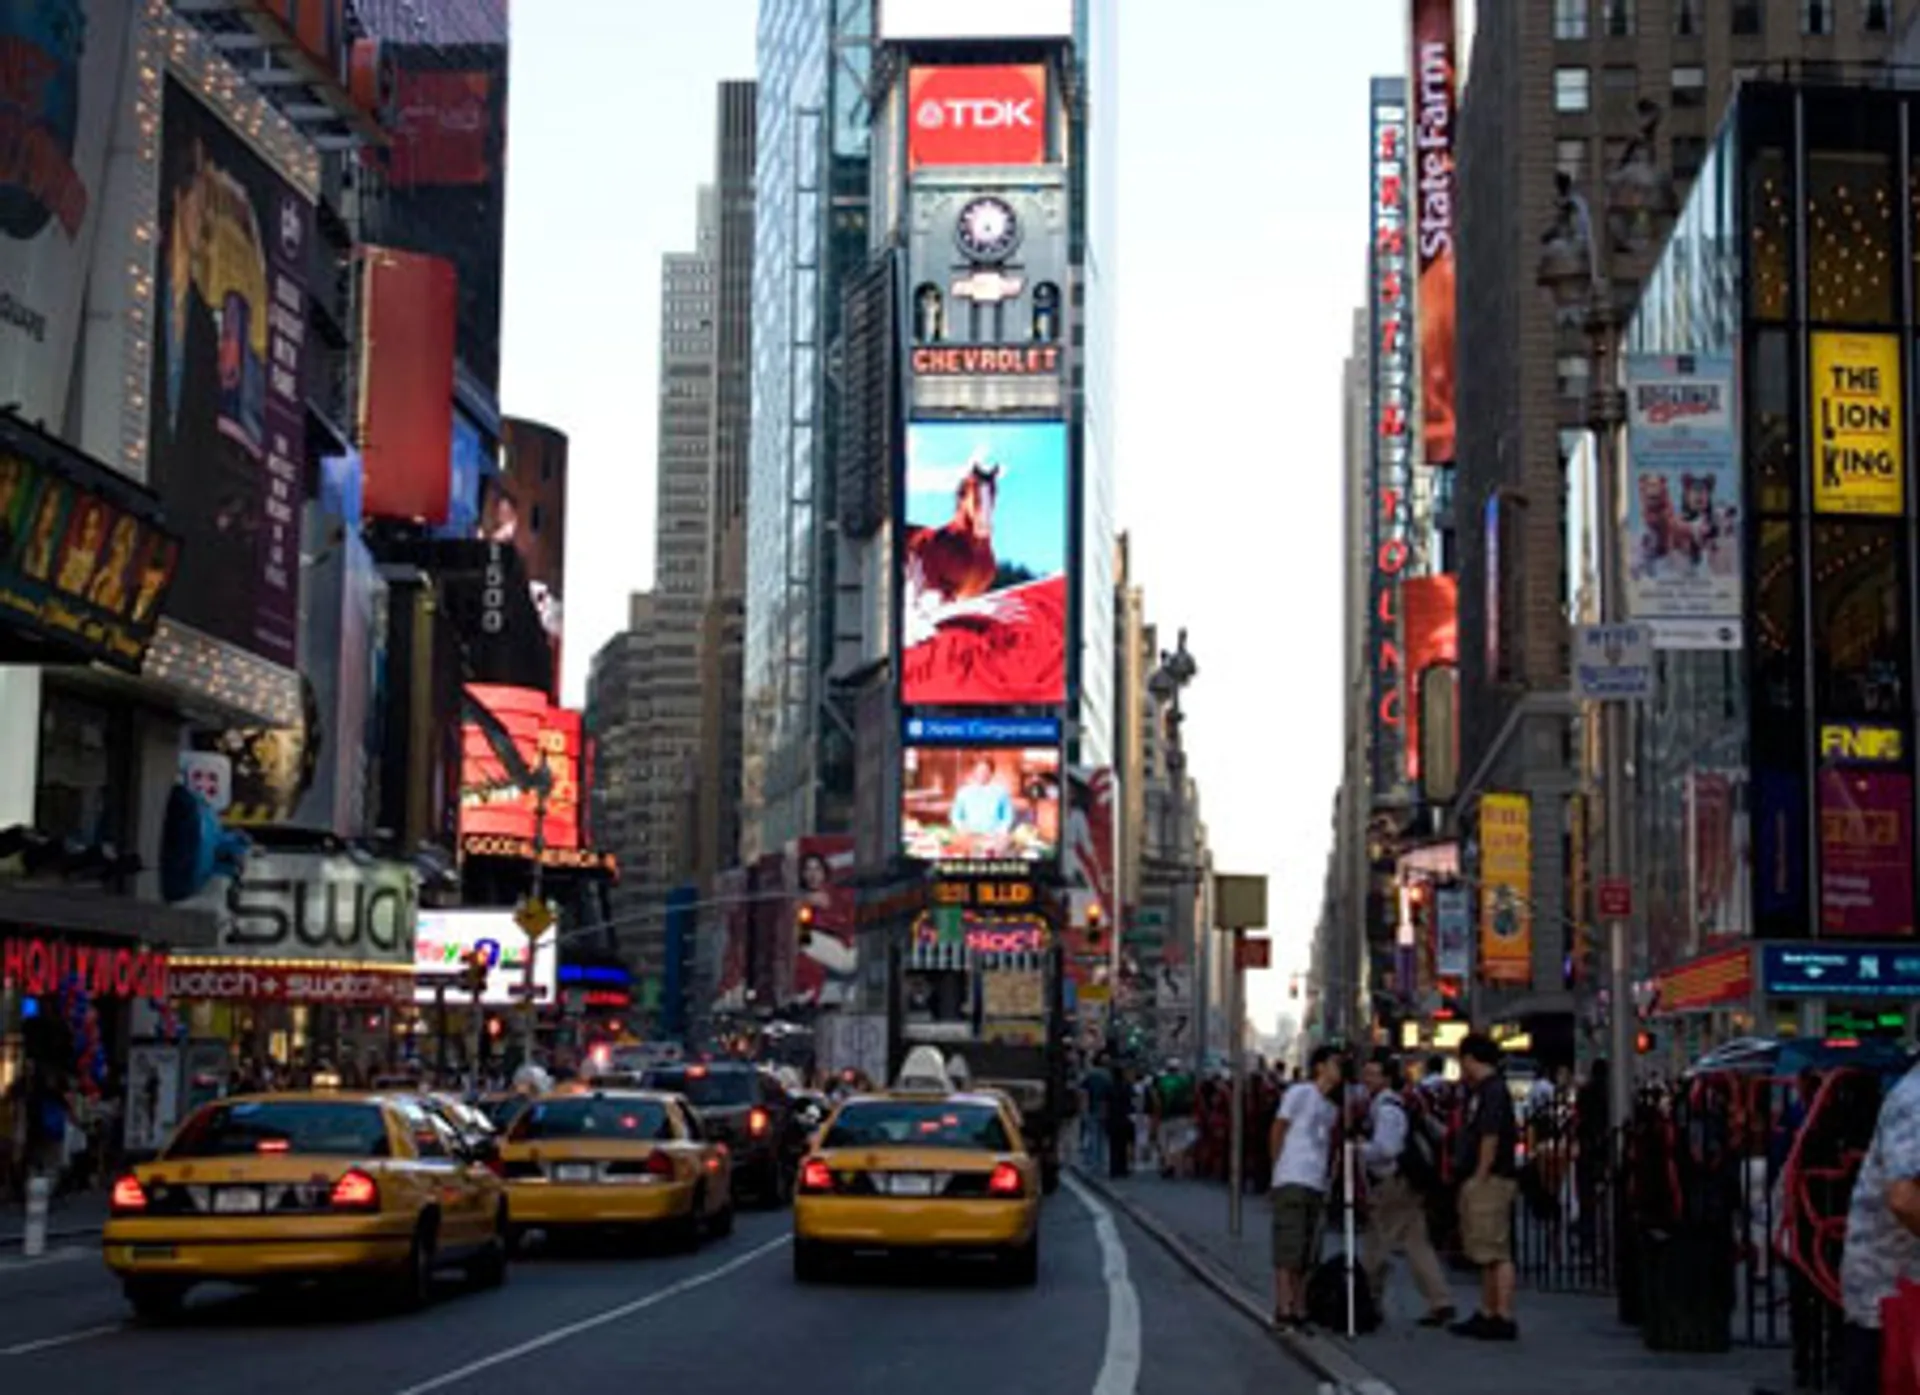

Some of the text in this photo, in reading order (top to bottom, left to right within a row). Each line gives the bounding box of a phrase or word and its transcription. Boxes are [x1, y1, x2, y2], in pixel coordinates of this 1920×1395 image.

[944, 98, 1034, 128] TDK
[1417, 42, 1453, 257] State Farm
[912, 347, 1058, 374] CHEVROLET
[1831, 365, 1880, 390] THE
[1822, 397, 1891, 440] LION
[1822, 446, 1895, 487] KING
[226, 878, 414, 951] swa
